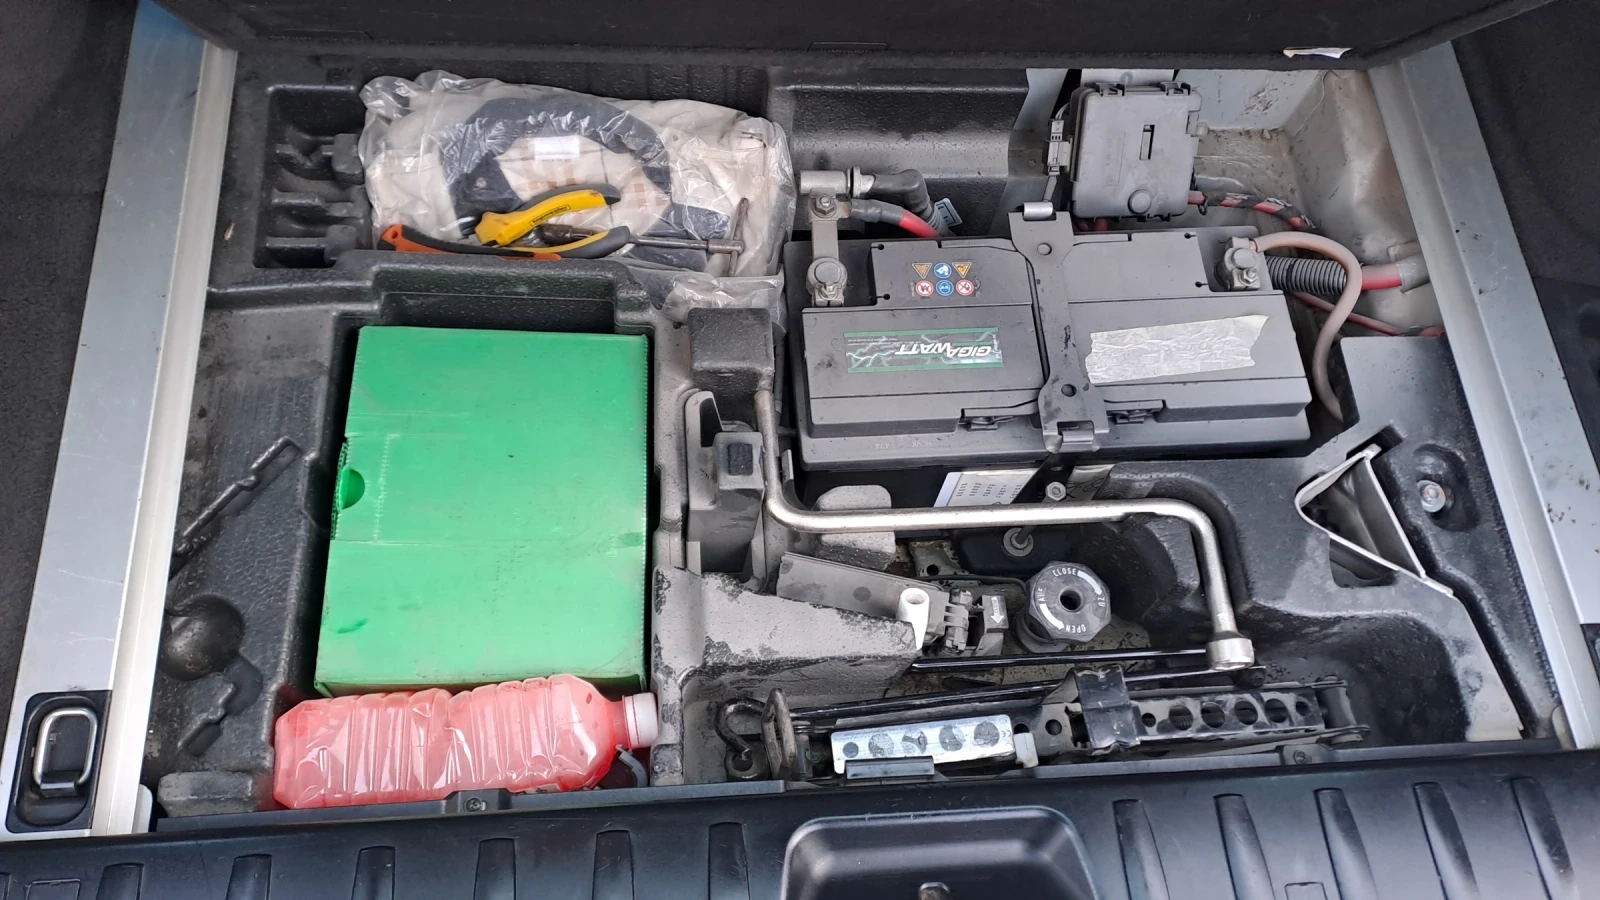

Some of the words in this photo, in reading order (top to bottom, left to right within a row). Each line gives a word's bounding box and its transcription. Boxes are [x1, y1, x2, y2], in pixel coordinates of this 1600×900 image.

[894, 342, 992, 357] GIGAWATT
[1052, 567, 1077, 577] CLOSE
[1097, 596, 1106, 607] ZU
[1065, 623, 1087, 634] OPEN
